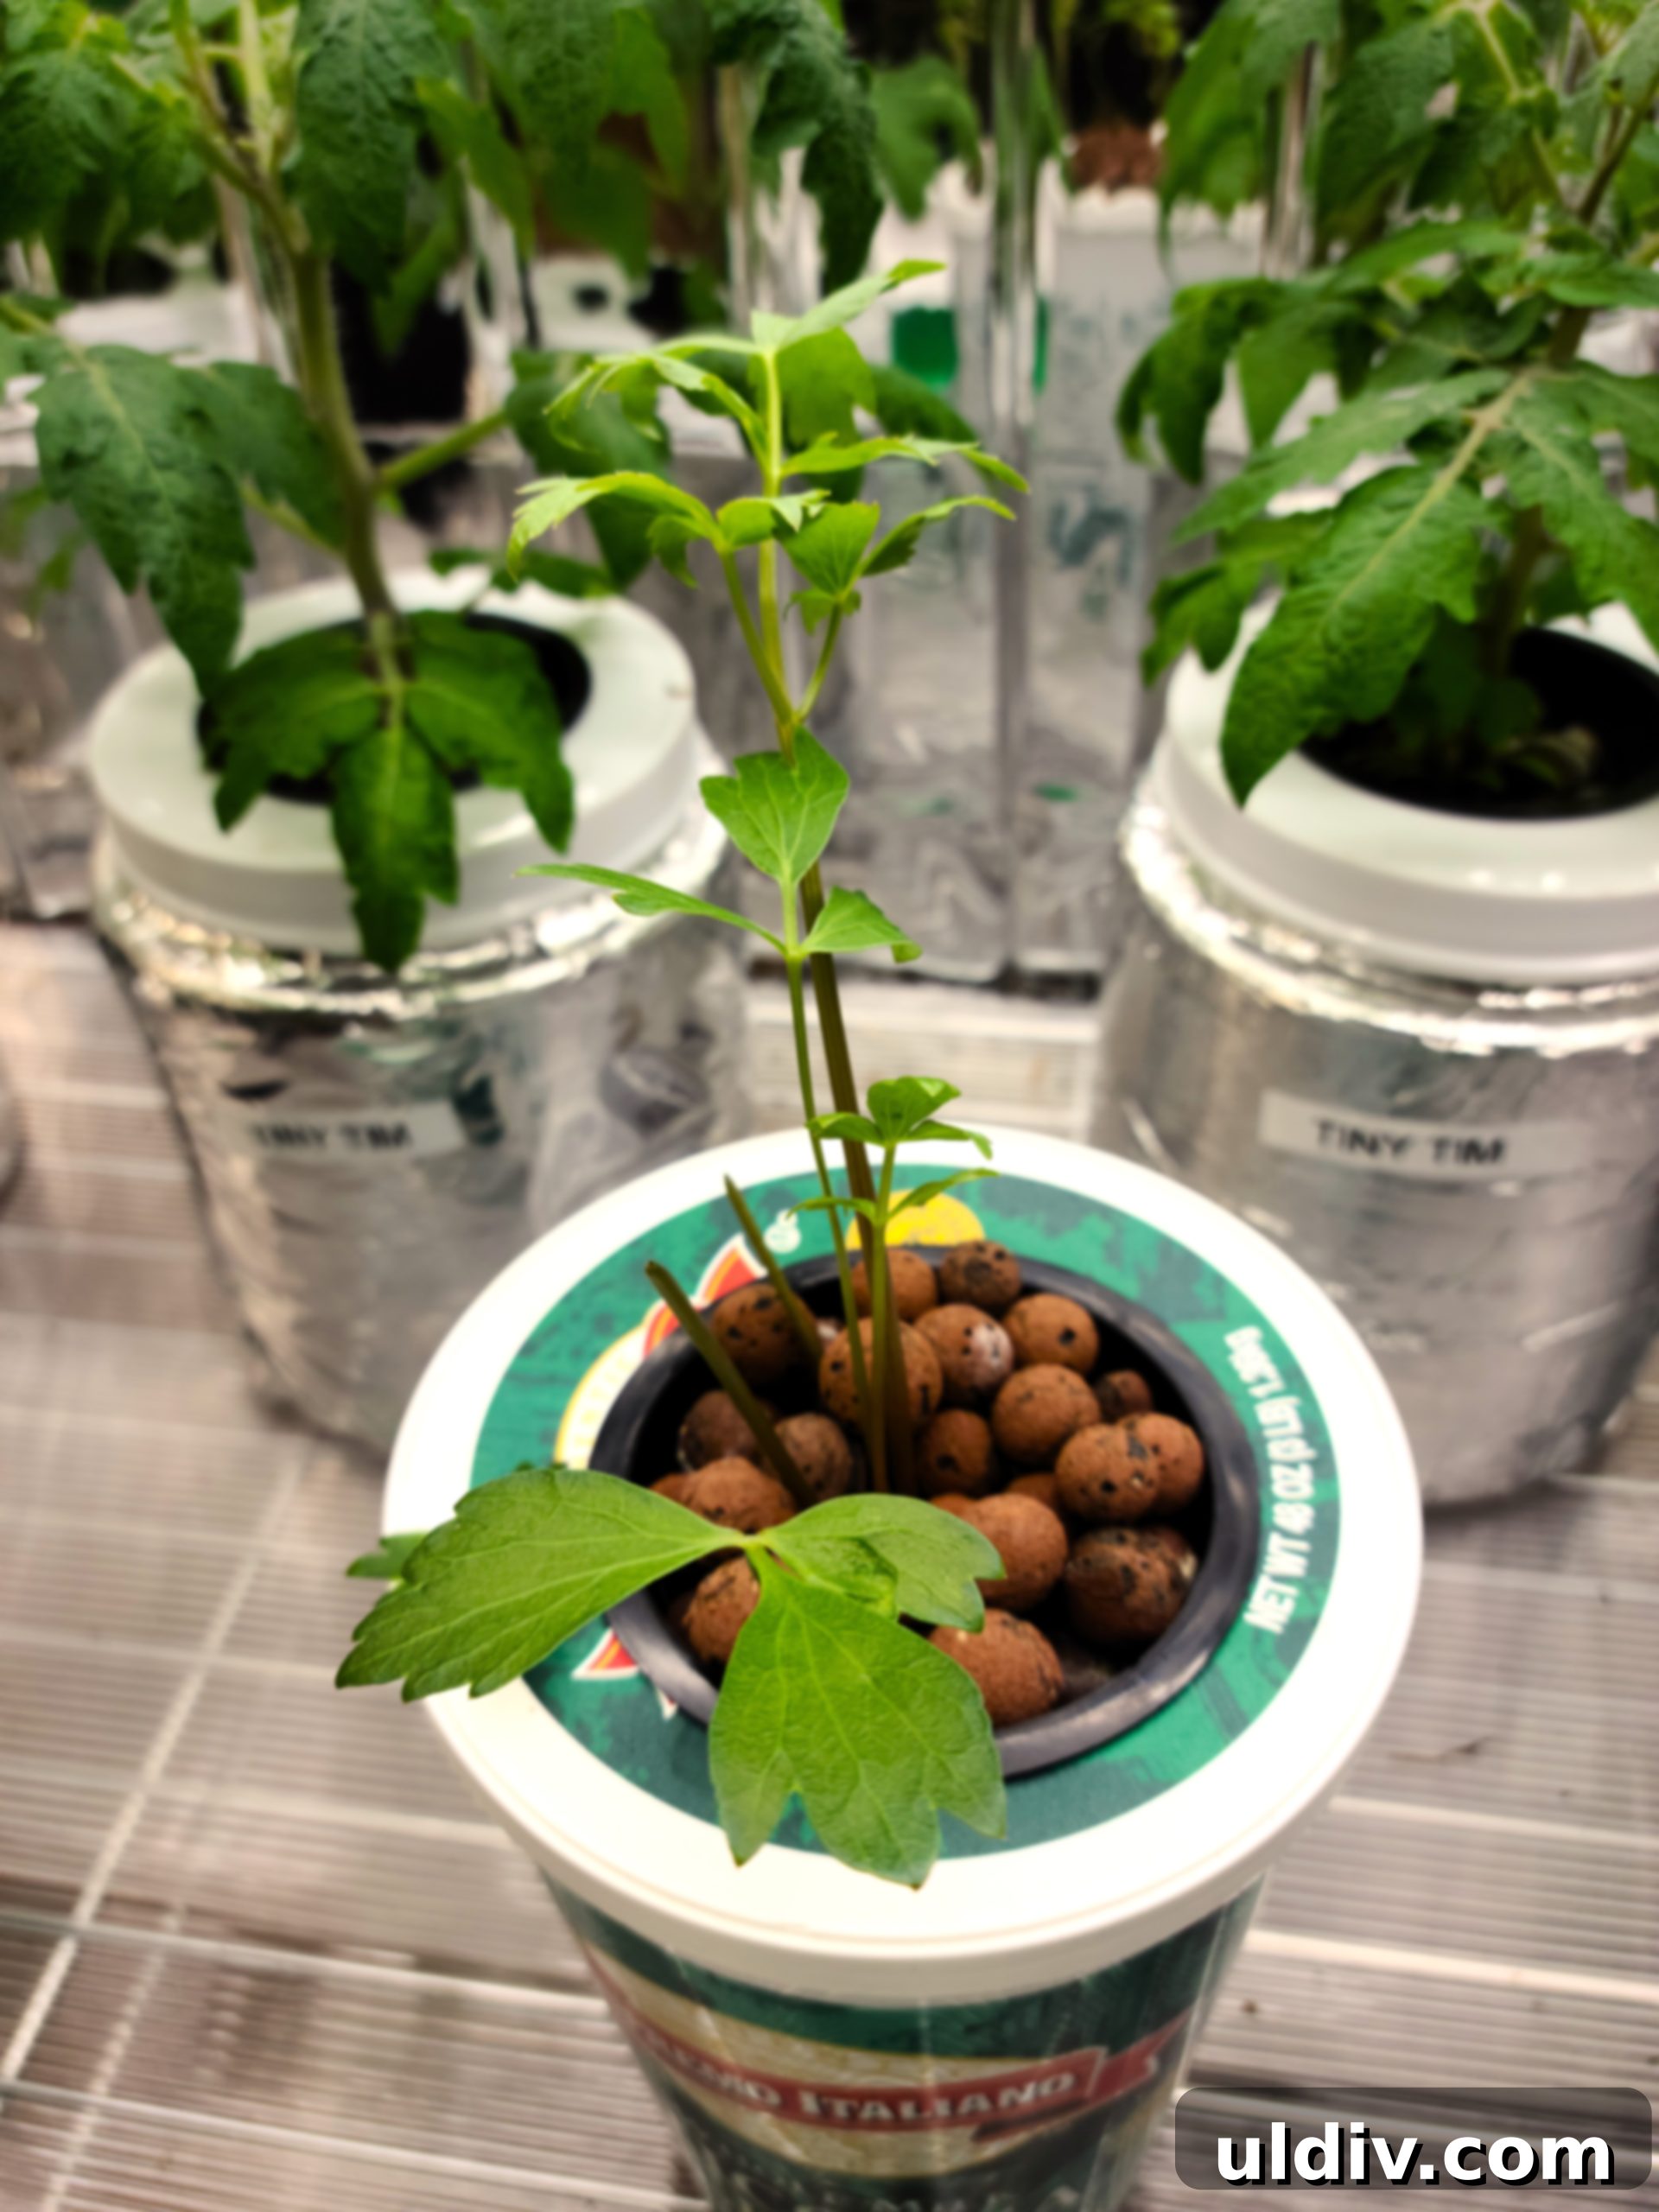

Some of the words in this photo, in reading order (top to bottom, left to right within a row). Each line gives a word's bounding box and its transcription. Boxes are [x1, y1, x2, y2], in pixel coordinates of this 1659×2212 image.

[1317, 1121, 1409, 1159] TINY
[1433, 1137, 1507, 1163] TIM
[1271, 1464, 1314, 1499] OZ
[1264, 1534, 1311, 1577] WT
[1243, 1575, 1300, 1635] NET
[798, 2072, 1077, 2122] ITALIANO
